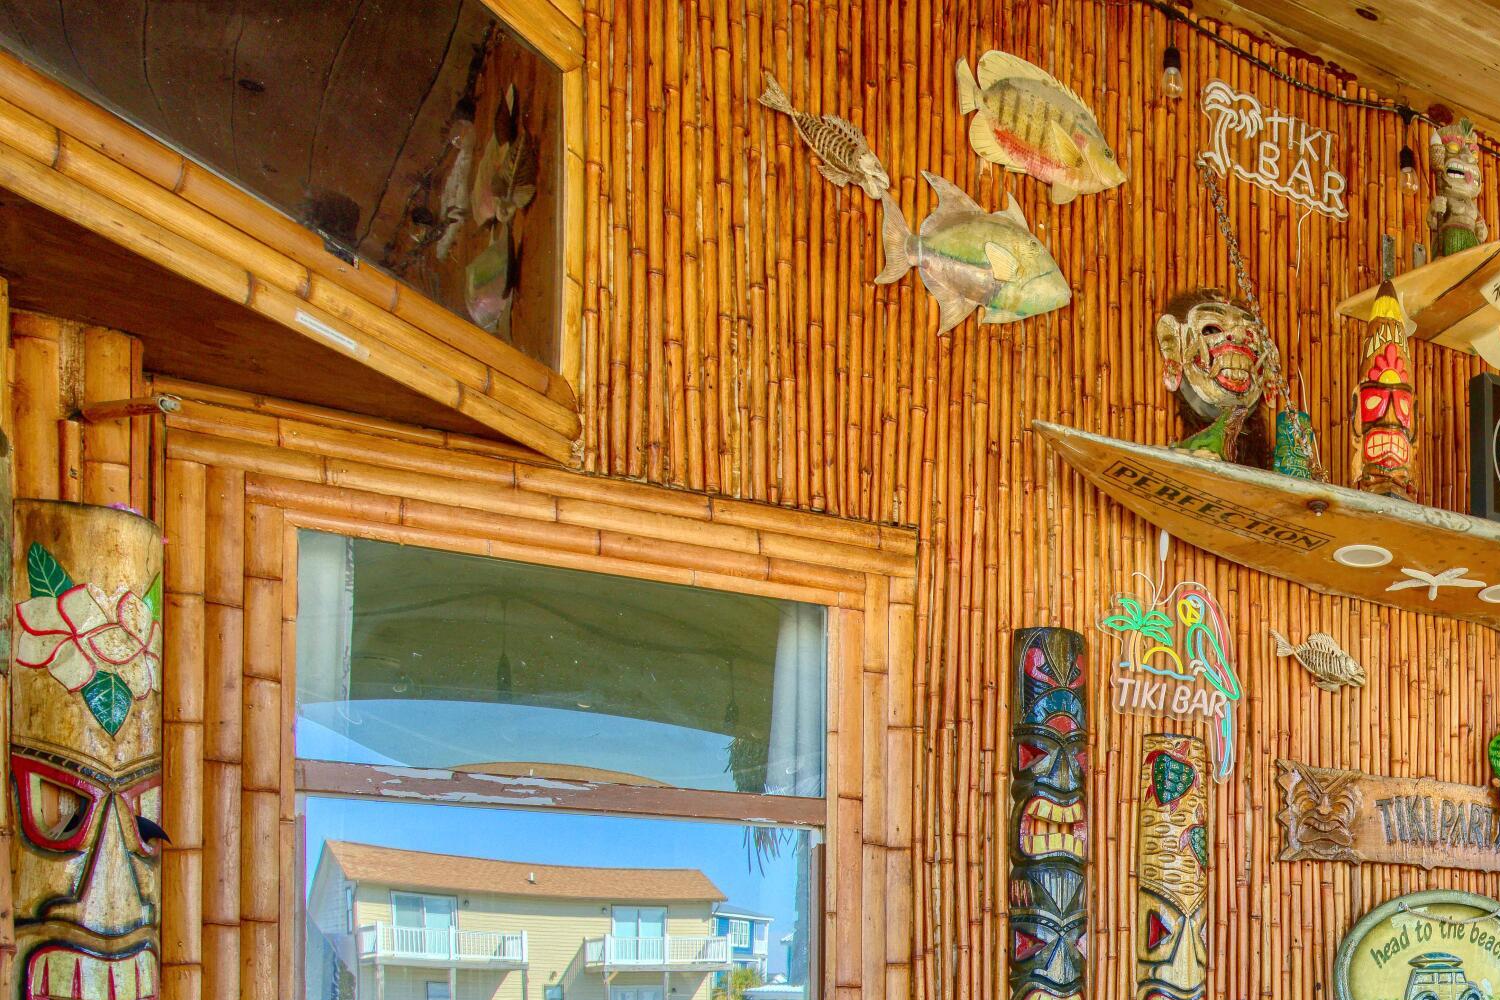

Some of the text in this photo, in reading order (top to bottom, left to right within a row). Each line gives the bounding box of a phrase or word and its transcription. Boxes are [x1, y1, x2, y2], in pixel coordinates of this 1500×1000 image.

[1265, 109, 1332, 167] TIKI
[1259, 141, 1346, 209] BAR
[1111, 466, 1322, 548] PERFECTION
[1117, 677, 1228, 719] TIKI BAR
[1375, 795, 1433, 846] TIKI
[1369, 924, 1412, 969] head
[1414, 919, 1433, 944] to
[1438, 915, 1466, 940] the
